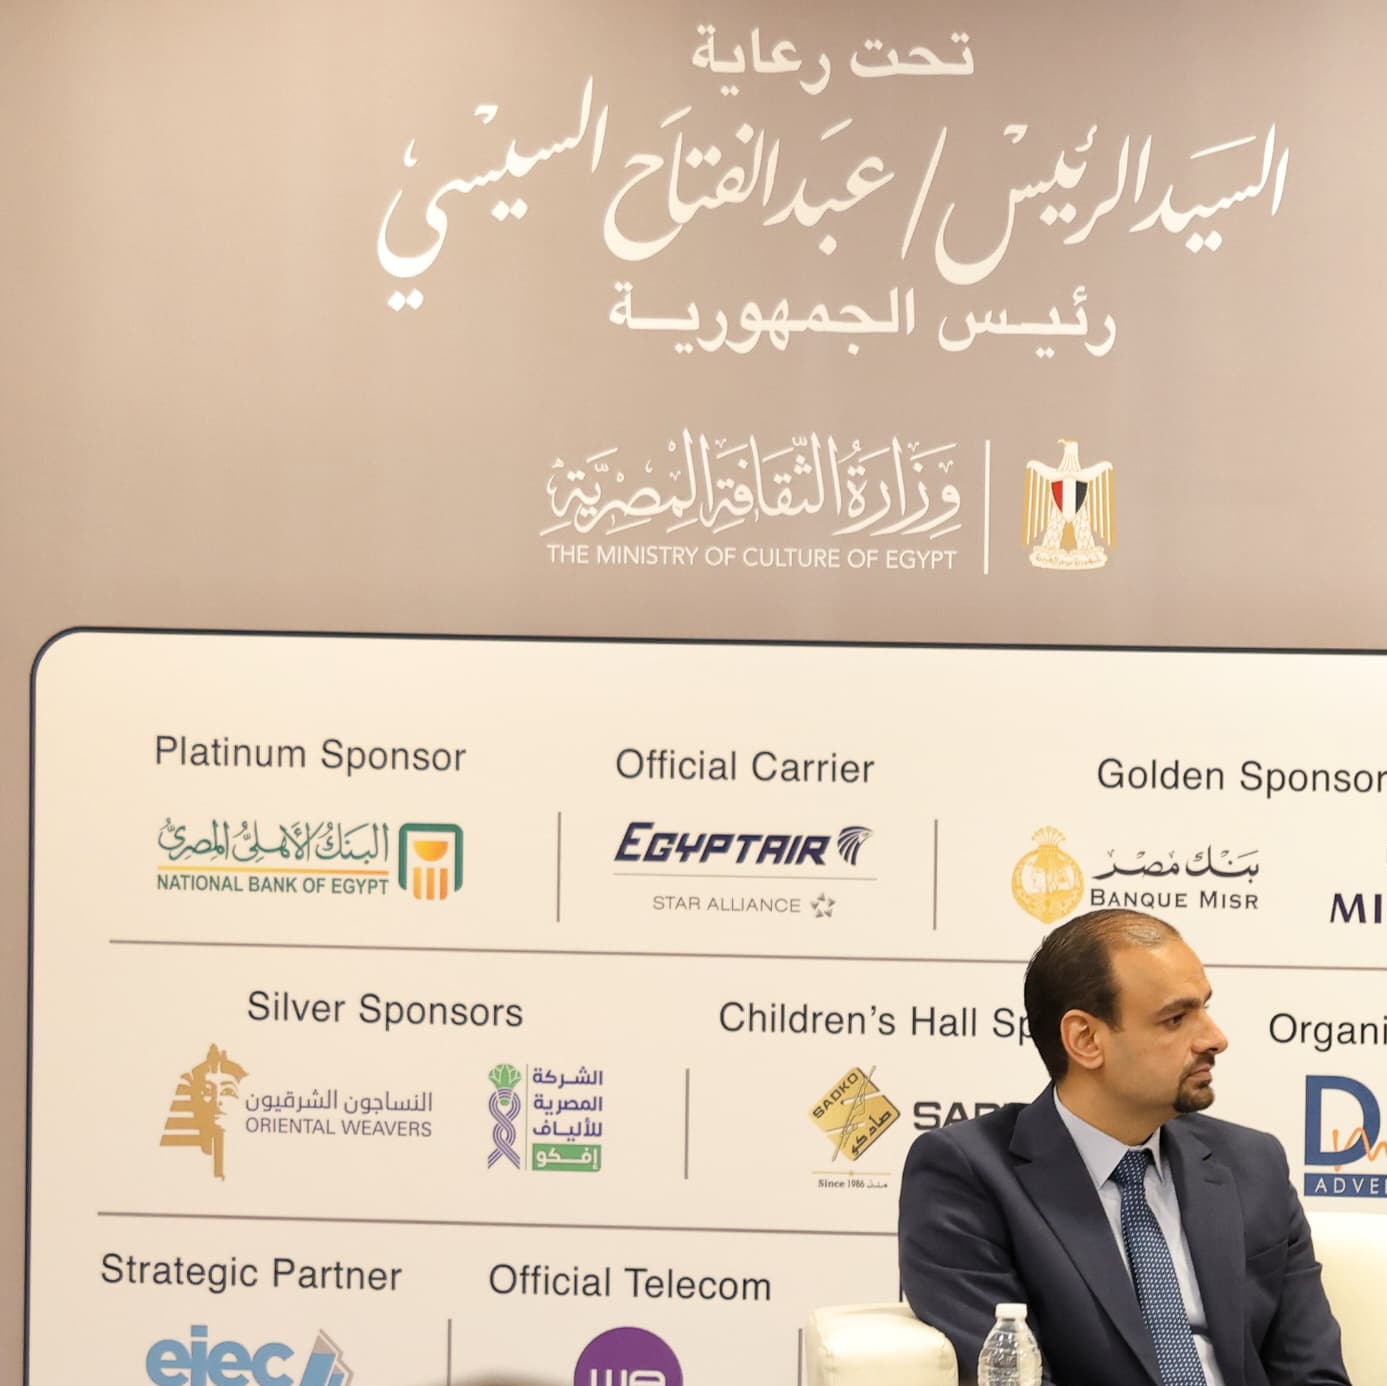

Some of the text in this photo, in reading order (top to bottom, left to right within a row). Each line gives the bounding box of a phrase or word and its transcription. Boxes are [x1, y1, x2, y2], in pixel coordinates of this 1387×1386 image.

[691, 24, 975, 96] تحت رعاية
[376, 76, 609, 310] السيسي
[935, 124, 1152, 285] الرئيس
[1129, 122, 1289, 253] السيد
[608, 280, 1117, 359] رئيس الجمهورية
[540, 427, 962, 540] وزارة الثقافة المصرية
[547, 544, 958, 570] THE MINISTRY OF CULTURE OF EGYPT
[156, 735, 467, 777] Platinum Sponsor
[616, 747, 875, 784] Official Carrier
[1097, 757, 1224, 791] Golden
[613, 821, 832, 866] EGYPTAIR
[1091, 844, 1260, 884] بنك مصر
[157, 873, 390, 895] NATIONAL BANK OF EGYPT
[652, 895, 801, 913] STAR ALLIANCE
[247, 990, 523, 1031] Silver Sponsors
[911, 1005, 977, 1037] Hall
[532, 1066, 604, 1088] الشركة
[812, 1072, 859, 1119] SADKO
[245, 1089, 433, 1114] النساجون الشرقيون
[532, 1096, 604, 1115] المصرية
[245, 1117, 432, 1137] ORIENTAL WEAVERS
[818, 1179, 845, 1189] Since
[101, 1252, 403, 1295] Strategic Partner
[489, 1263, 771, 1301] Official Telecom
